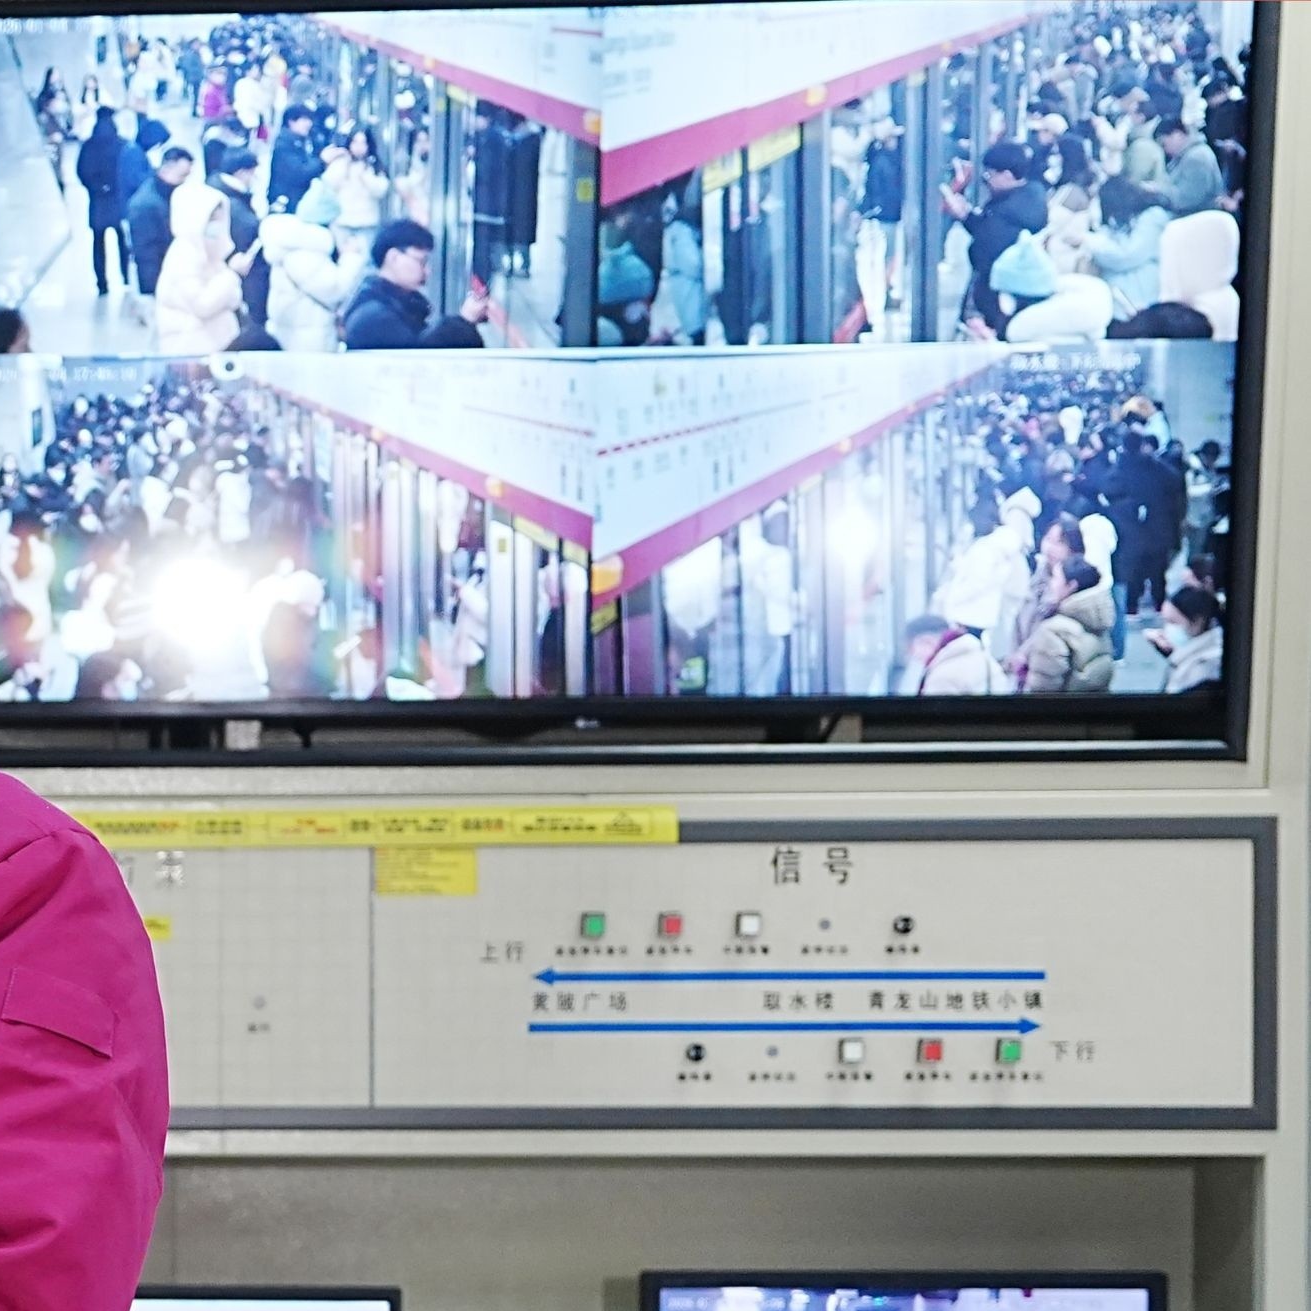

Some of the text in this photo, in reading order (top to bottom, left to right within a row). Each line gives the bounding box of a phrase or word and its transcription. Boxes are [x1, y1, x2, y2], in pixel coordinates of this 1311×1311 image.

[770, 846, 855, 886] 信号
[480, 941, 525, 962] 上行
[1050, 1040, 1095, 1062] 下行
